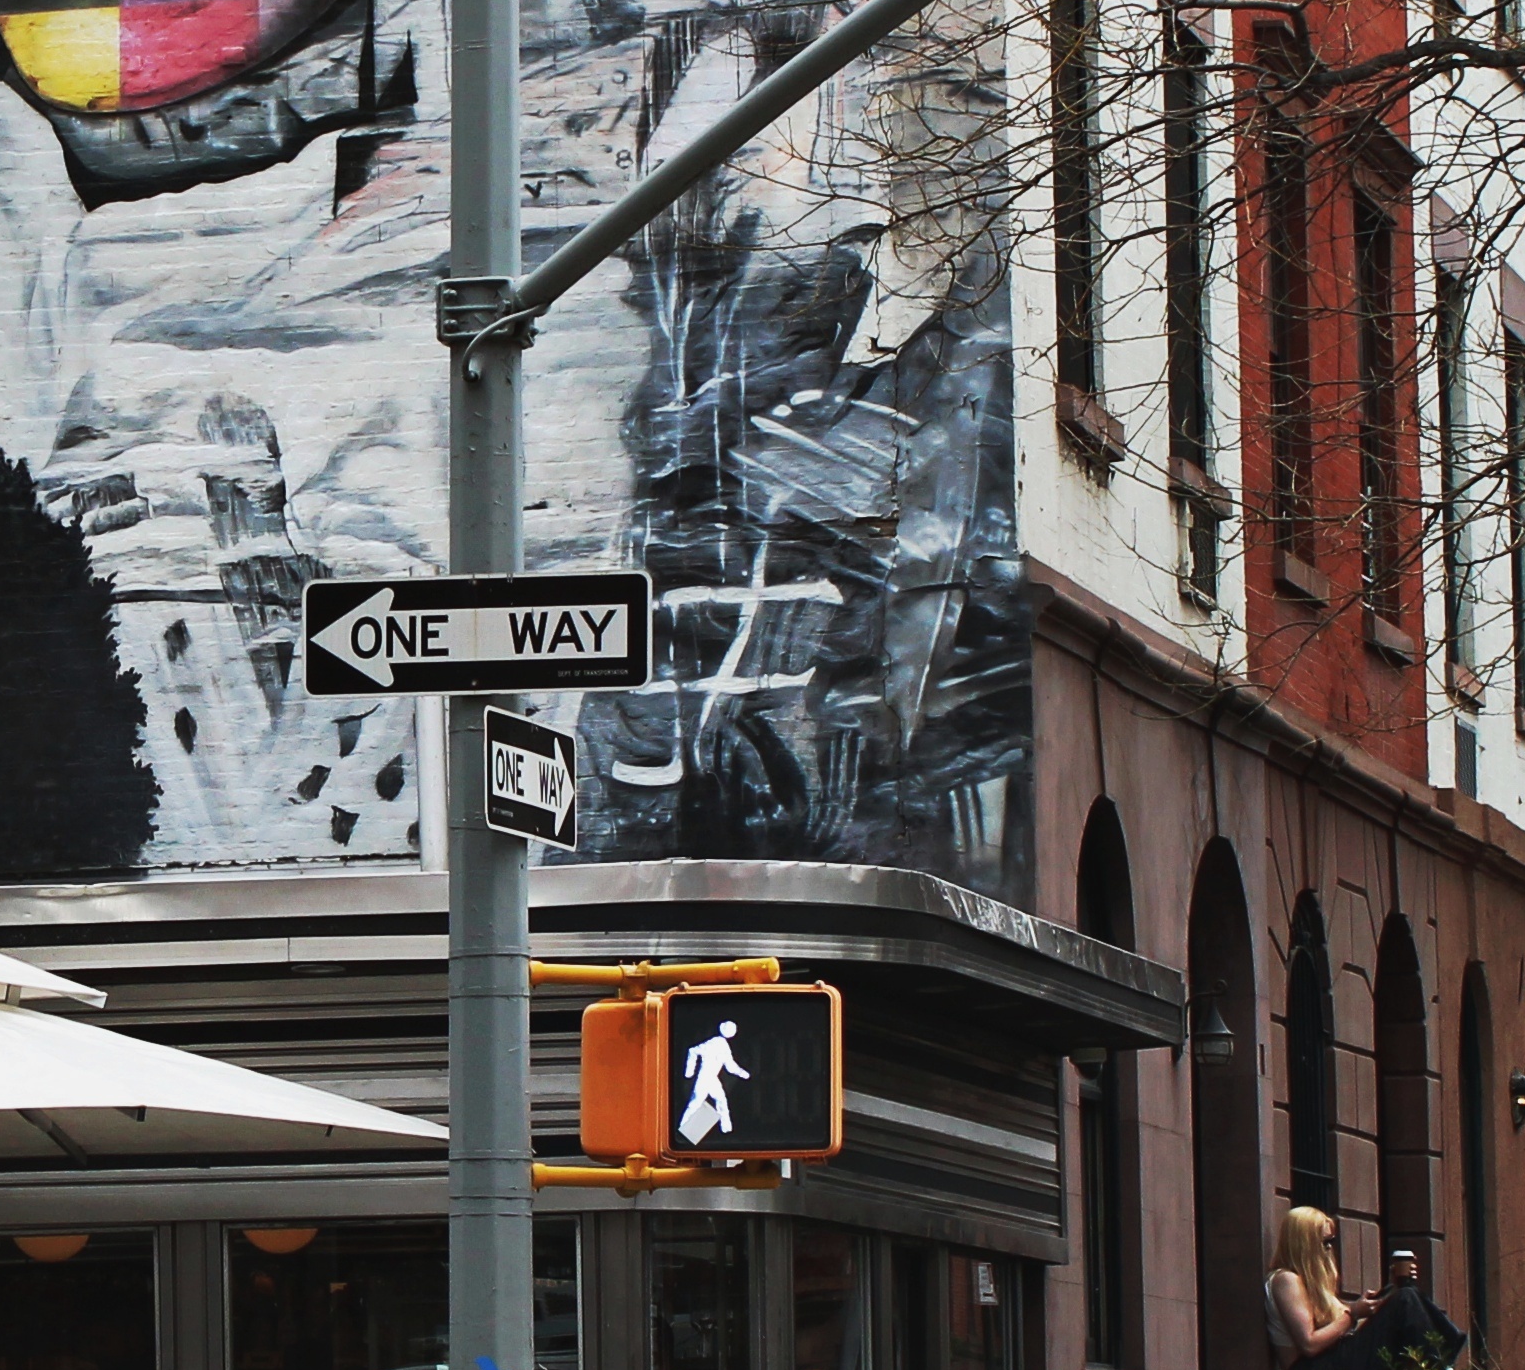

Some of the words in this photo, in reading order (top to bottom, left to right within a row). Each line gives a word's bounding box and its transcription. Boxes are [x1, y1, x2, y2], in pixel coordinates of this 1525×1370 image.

[350, 614, 449, 659] ONE
[508, 609, 617, 654] WAY
[495, 748, 524, 797] ONE
[538, 761, 565, 808] WAY
